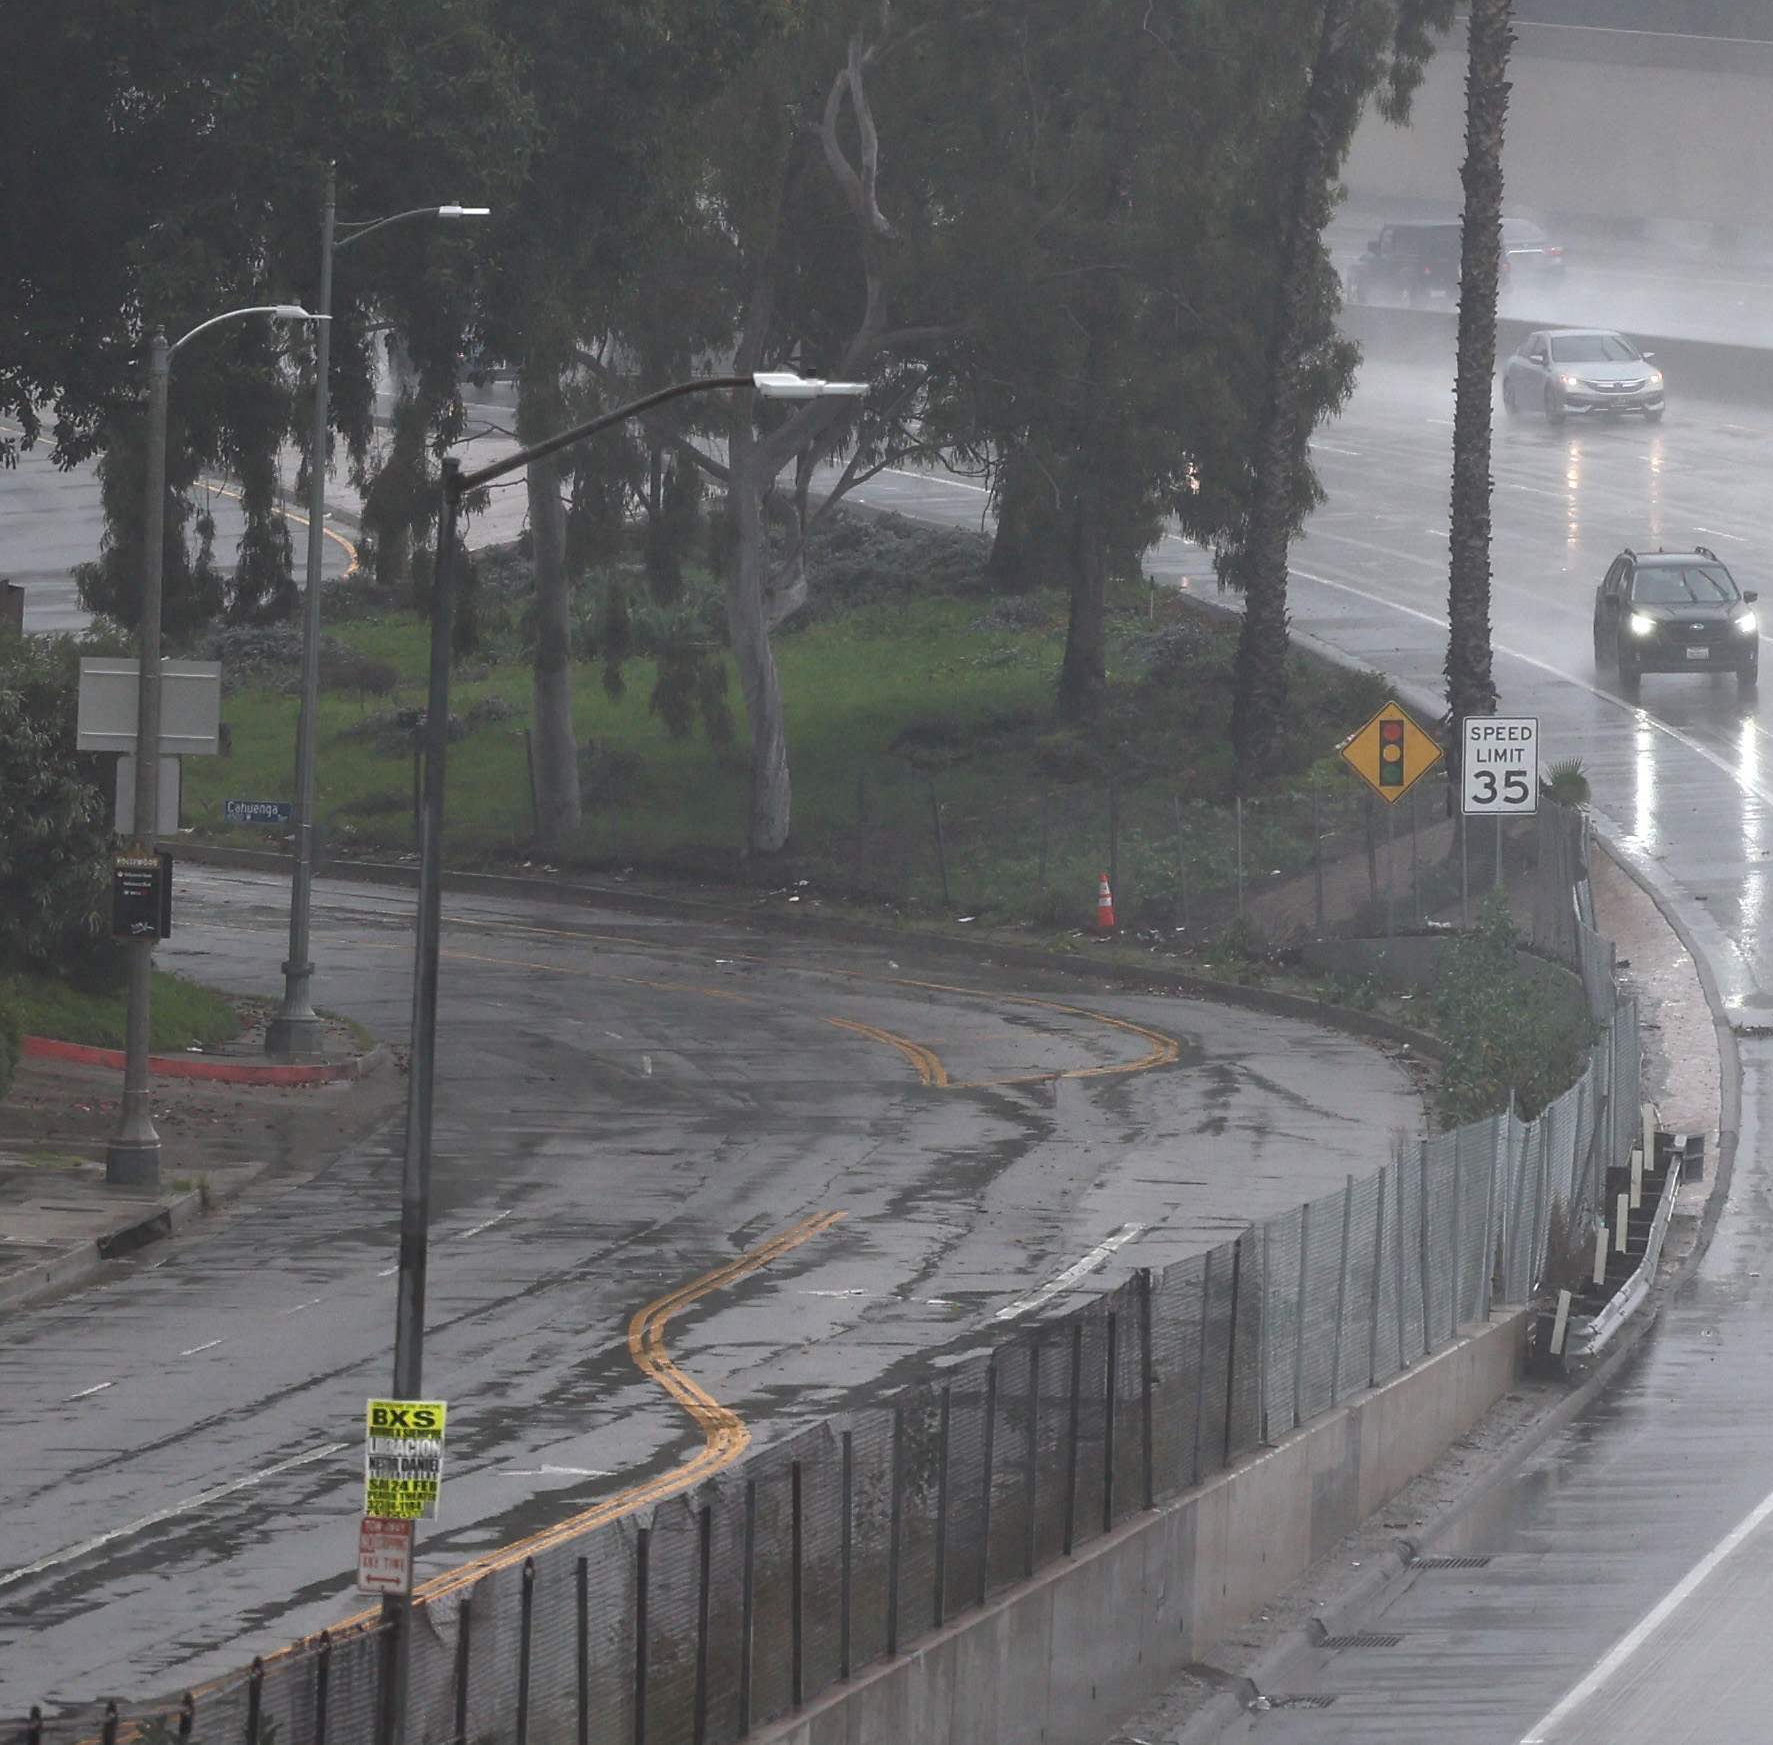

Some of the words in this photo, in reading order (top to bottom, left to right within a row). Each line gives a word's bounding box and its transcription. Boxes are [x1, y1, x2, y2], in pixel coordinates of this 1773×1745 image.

[1470, 726, 1532, 741] SPEED
[1476, 748, 1526, 763] LIMIT
[1471, 770, 1529, 805] 35
[227, 801, 278, 817] Cahuenga
[372, 1408, 436, 1428] BXS
